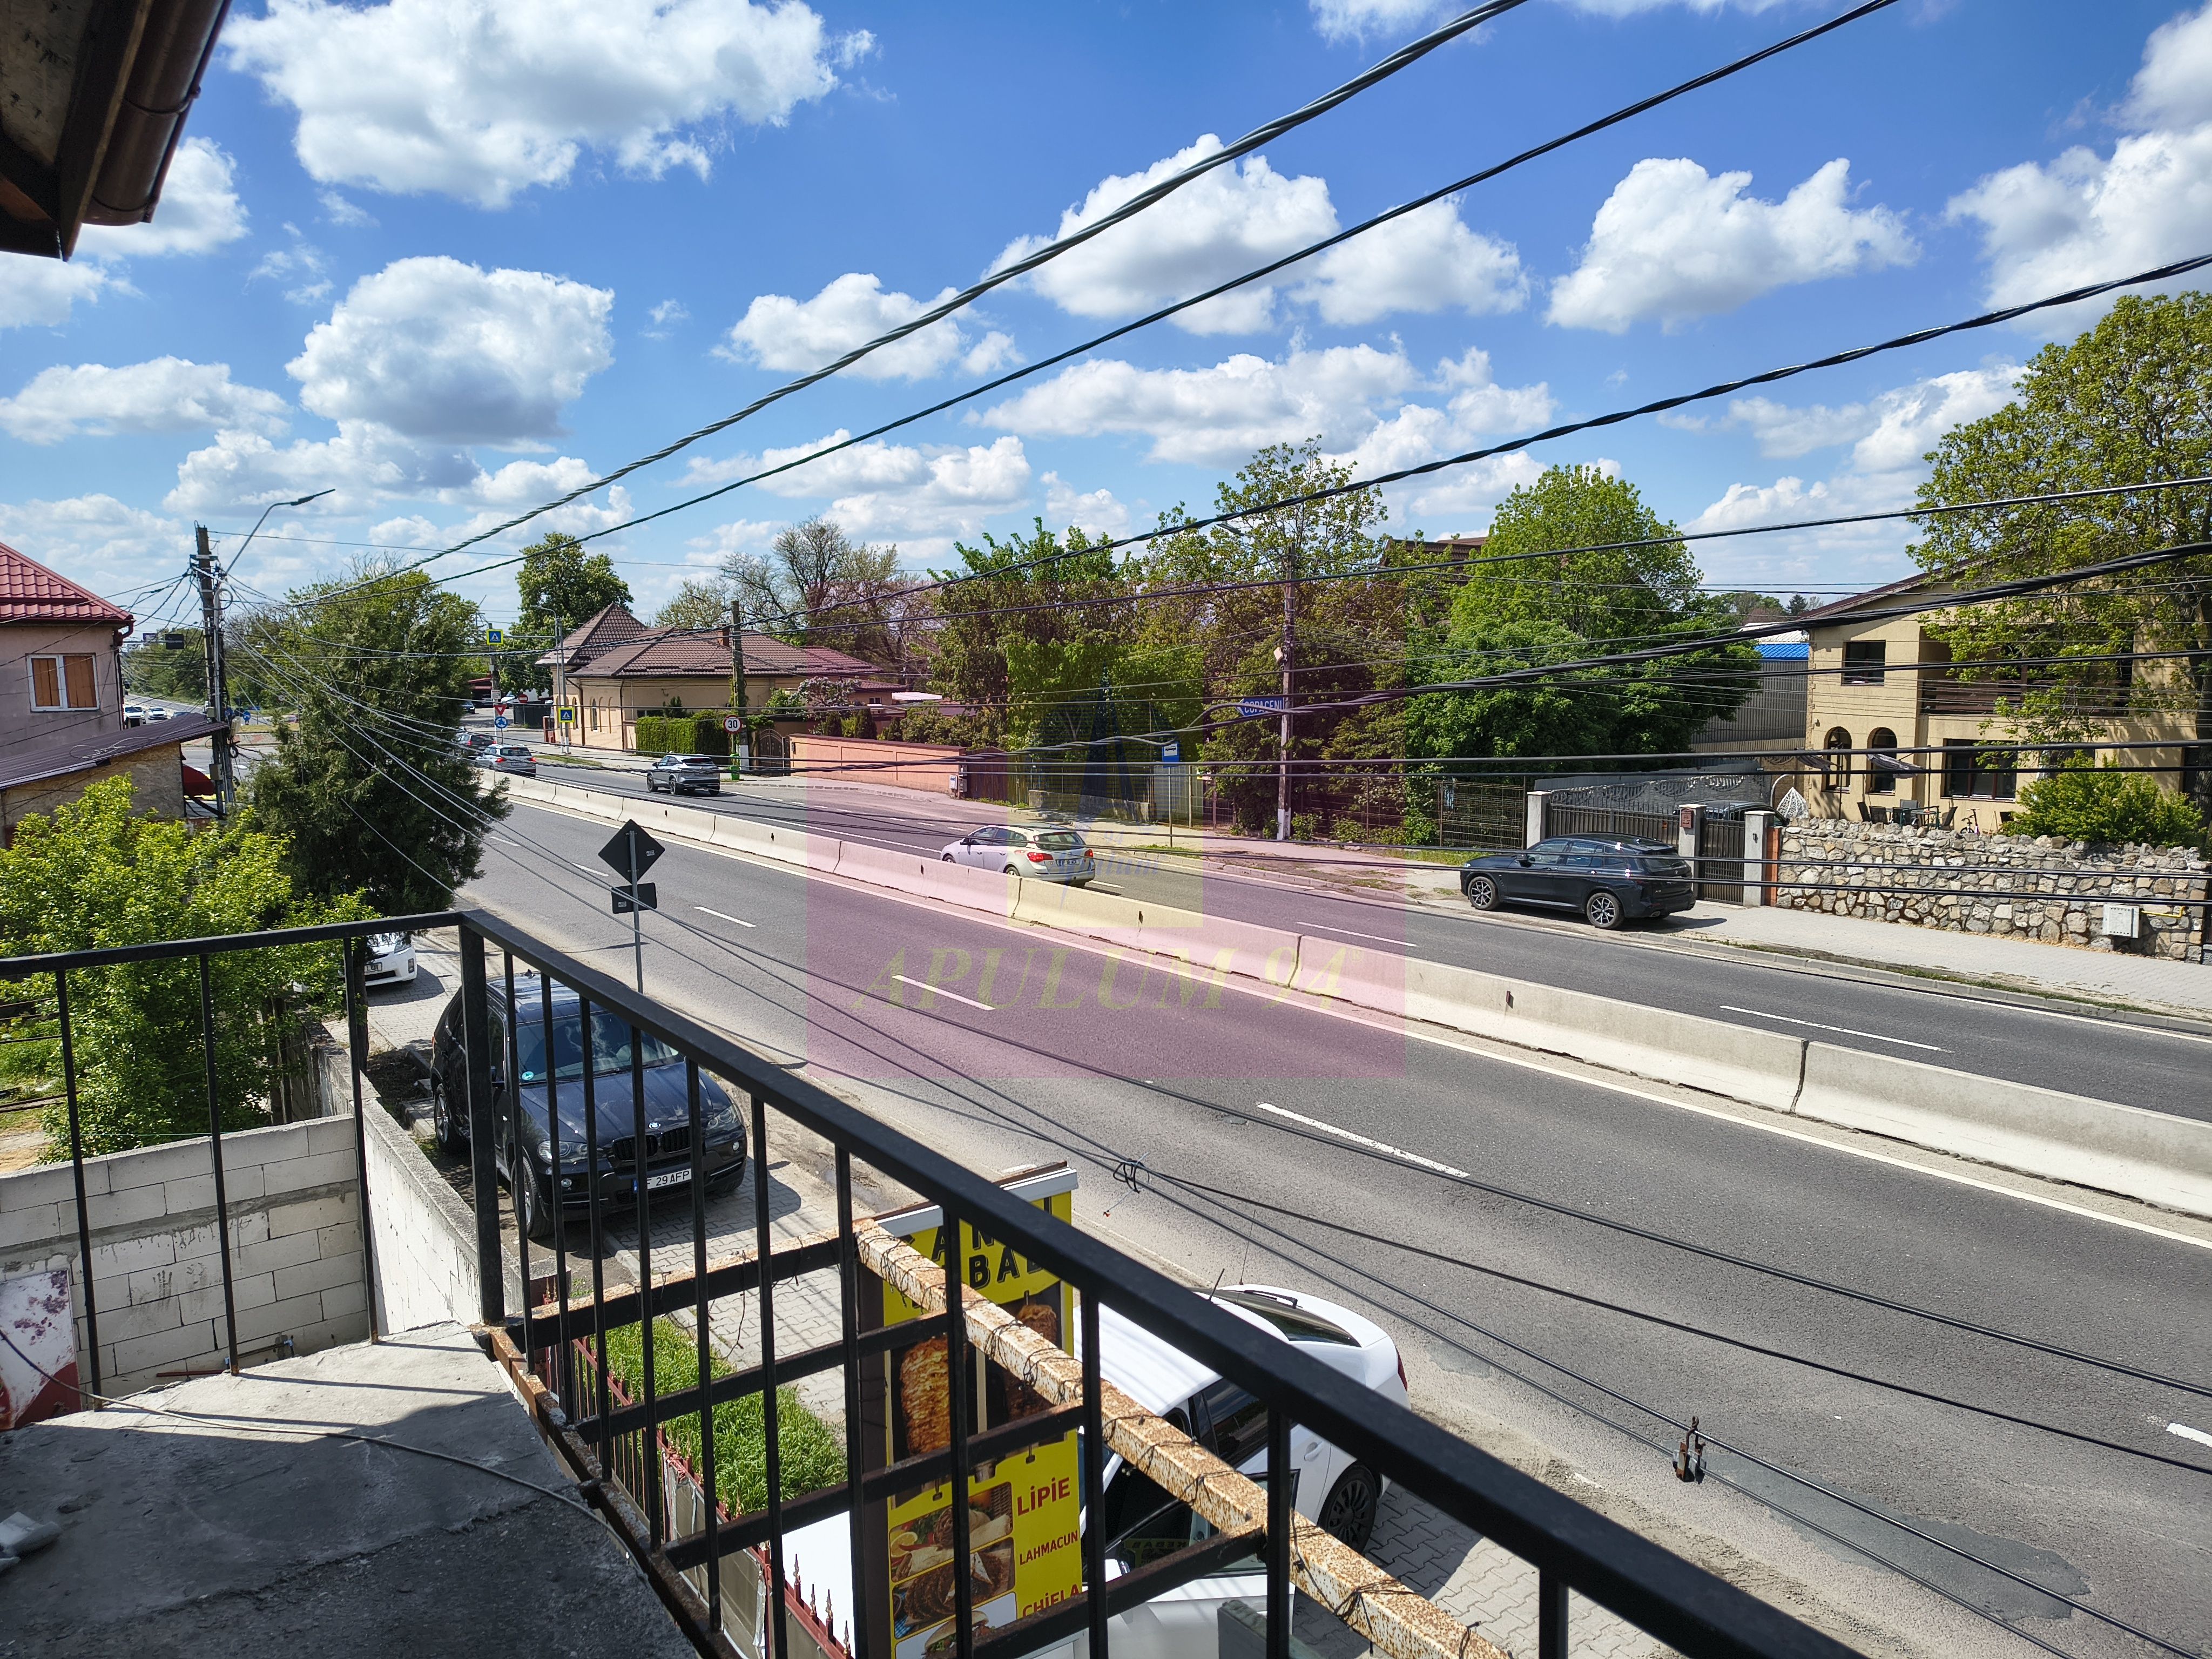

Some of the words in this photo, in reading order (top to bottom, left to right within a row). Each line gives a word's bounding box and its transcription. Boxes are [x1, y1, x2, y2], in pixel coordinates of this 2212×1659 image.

[728, 720, 738, 729] 30
[656, 1176, 668, 1186] 29
[670, 1170, 690, 1183] AFP
[1020, 1529, 1078, 1566] LAHMACUN
